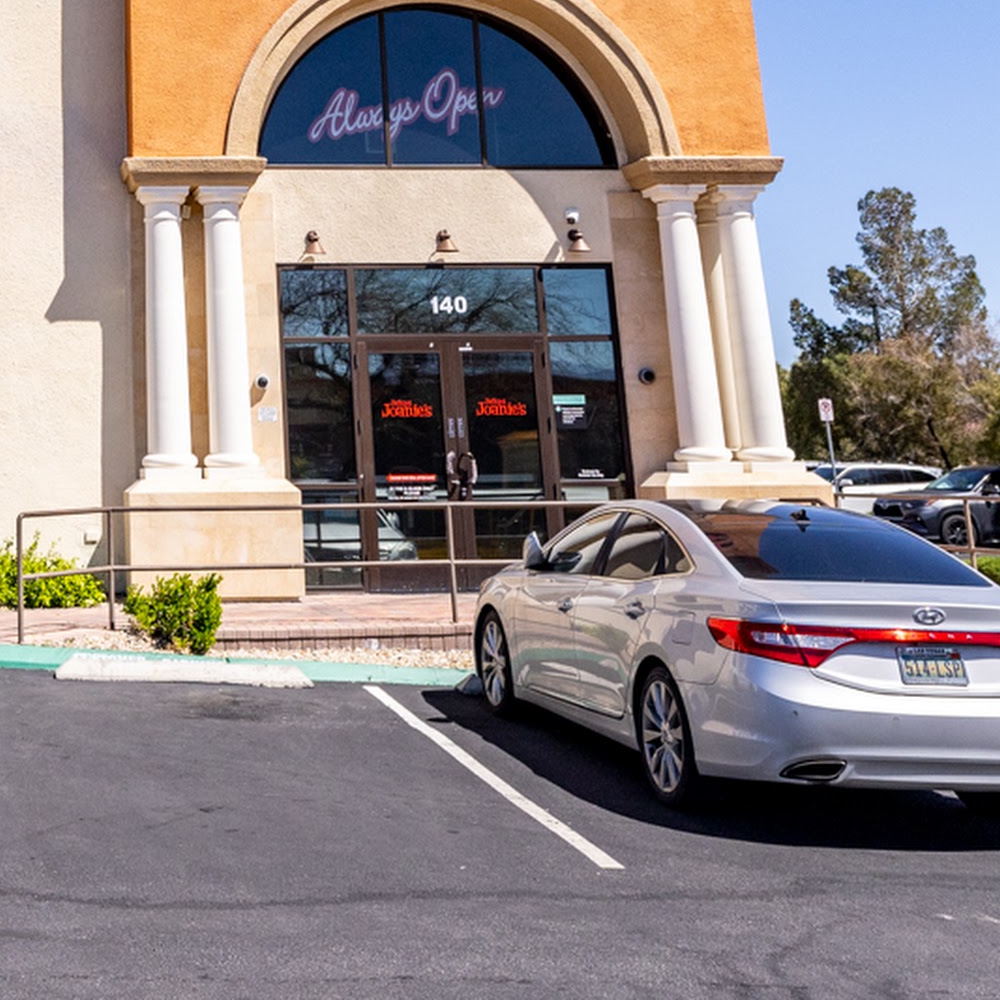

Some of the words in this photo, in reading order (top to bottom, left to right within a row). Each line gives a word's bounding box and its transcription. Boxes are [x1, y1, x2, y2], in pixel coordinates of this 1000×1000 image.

[309, 88, 421, 142] Always
[423, 67, 504, 136] Open
[430, 295, 468, 315] 140
